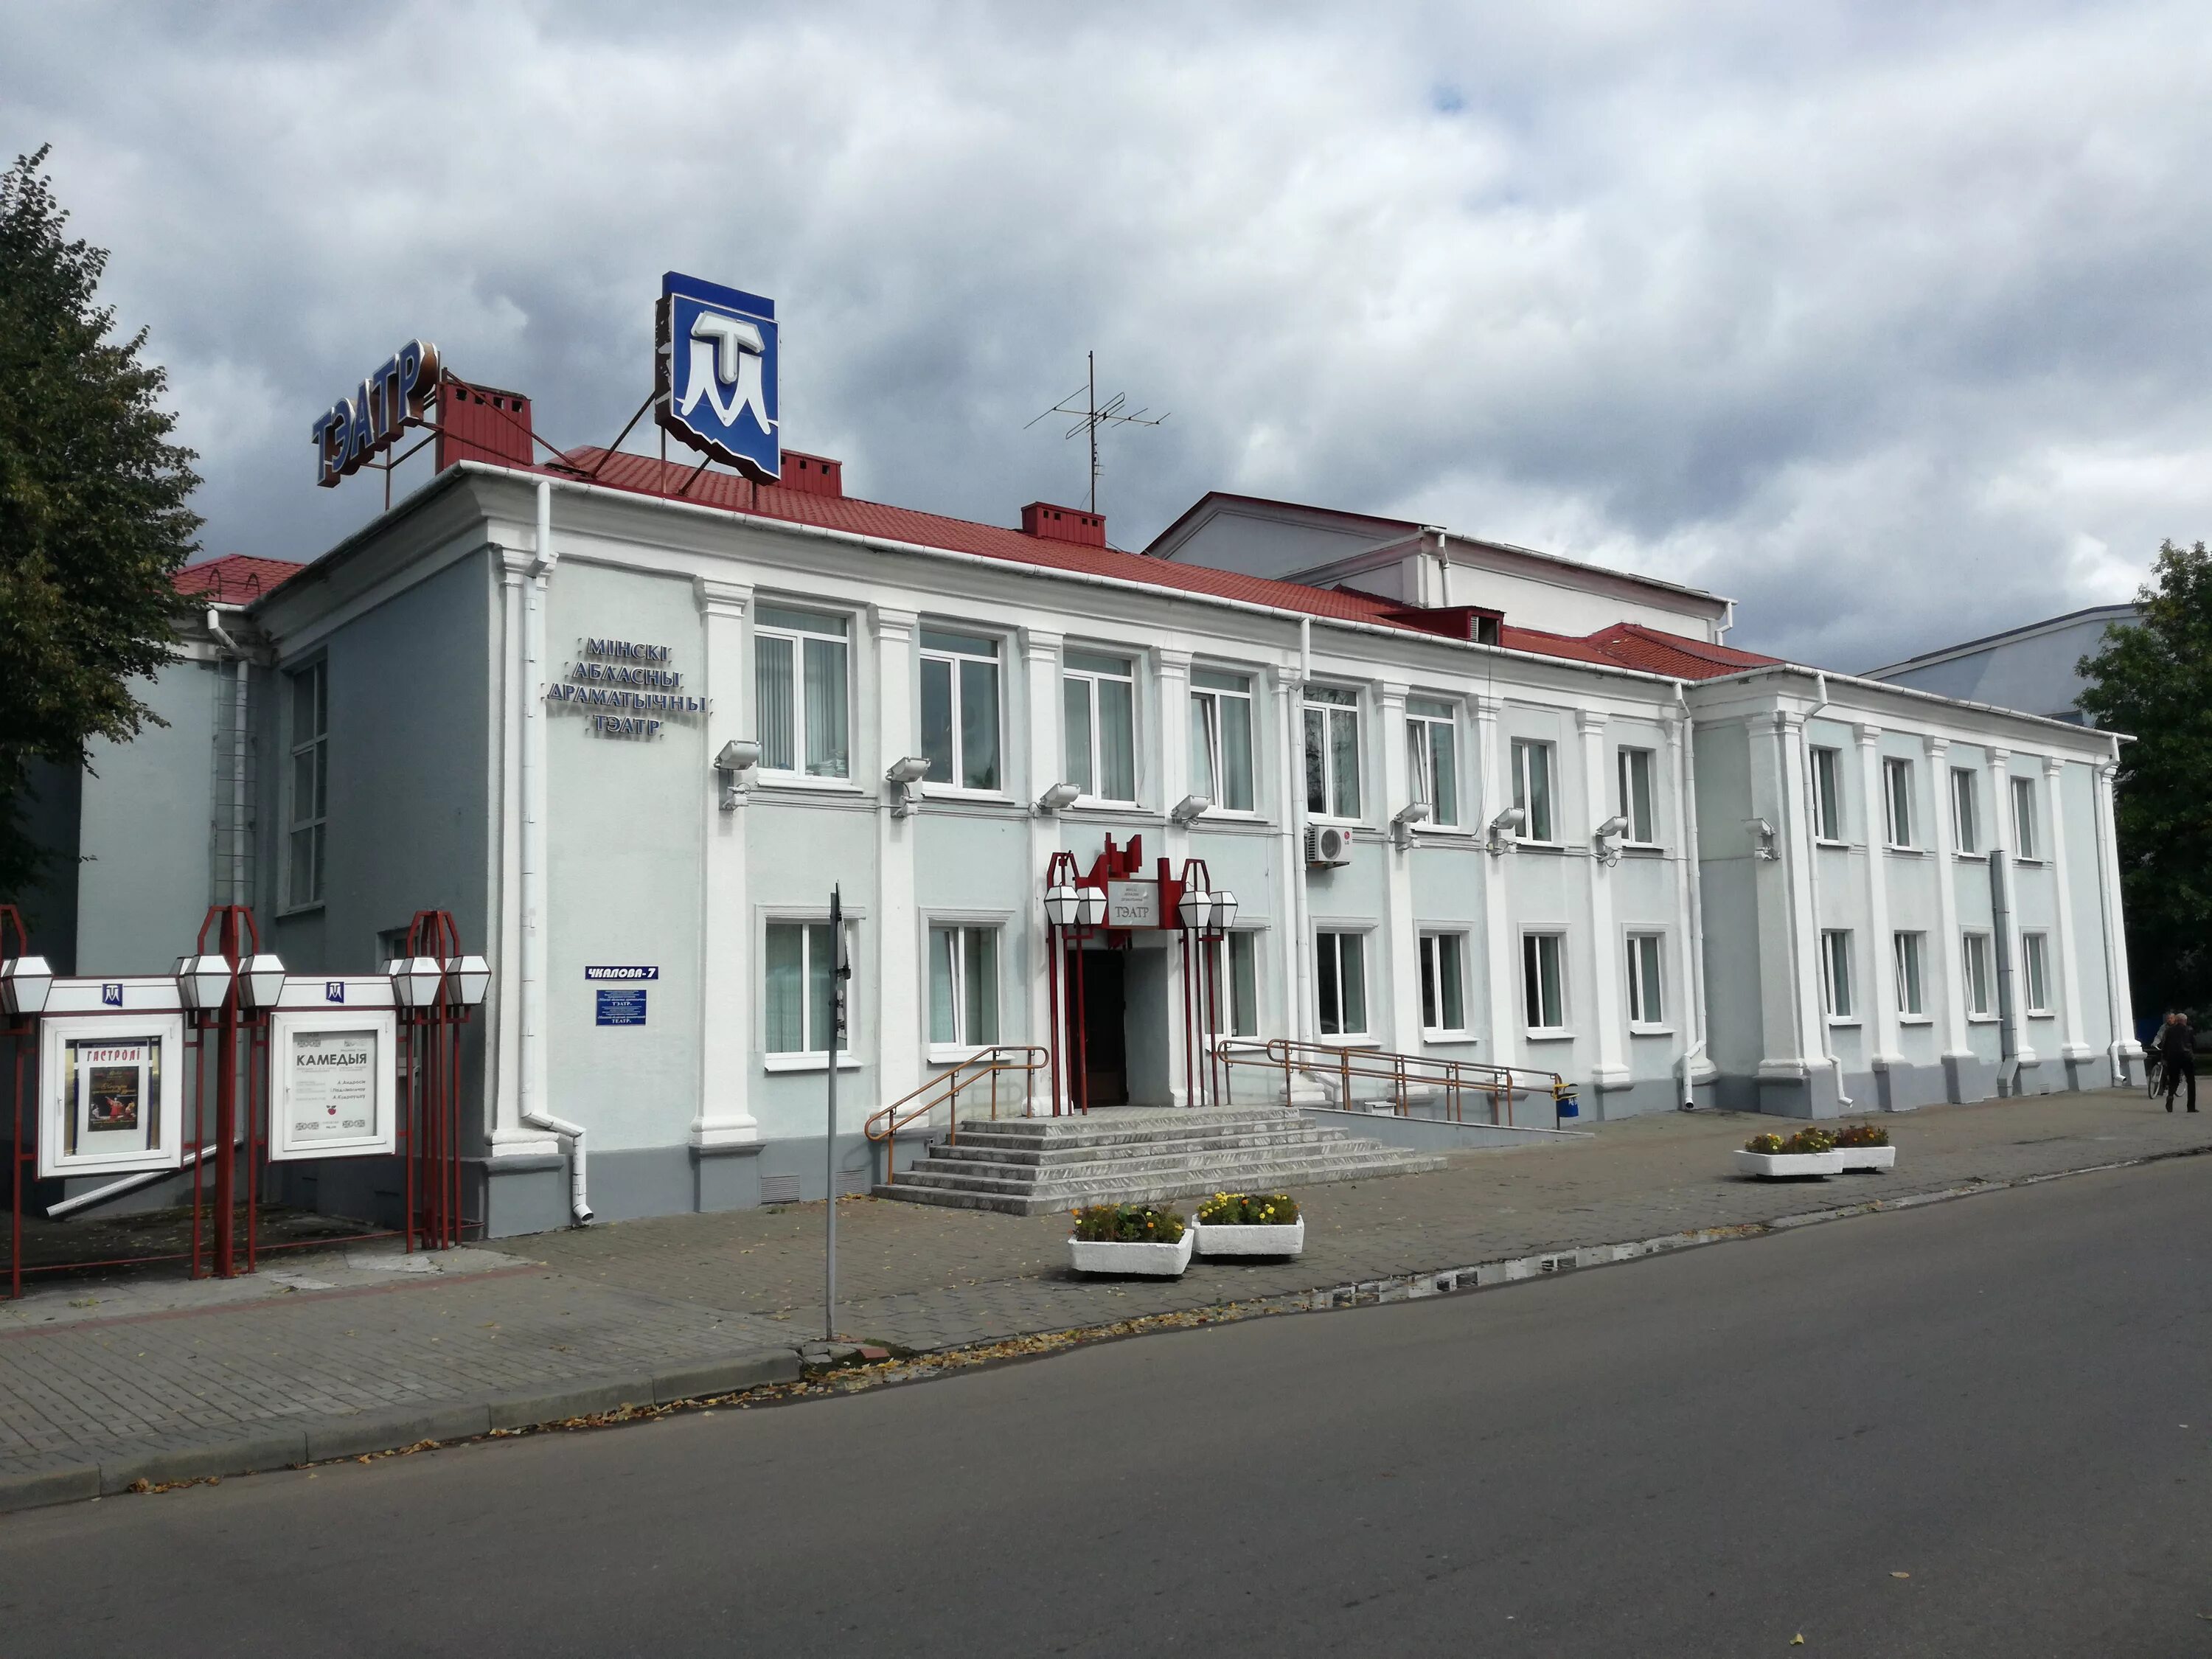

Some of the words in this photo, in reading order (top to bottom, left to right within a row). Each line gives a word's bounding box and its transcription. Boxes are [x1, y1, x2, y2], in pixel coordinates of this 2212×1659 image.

[312, 338, 435, 487] ТЭАТР
[588, 637, 667, 661] МІНСКІ
[572, 661, 680, 687] АБЛАСНЫ
[548, 683, 706, 712] ДРАМАТЫЧНЫ
[594, 714, 660, 734] ТЭАТР
[1115, 906, 1150, 918] ТЭАТР
[296, 1053, 366, 1065] КАМЕДЫЯ
